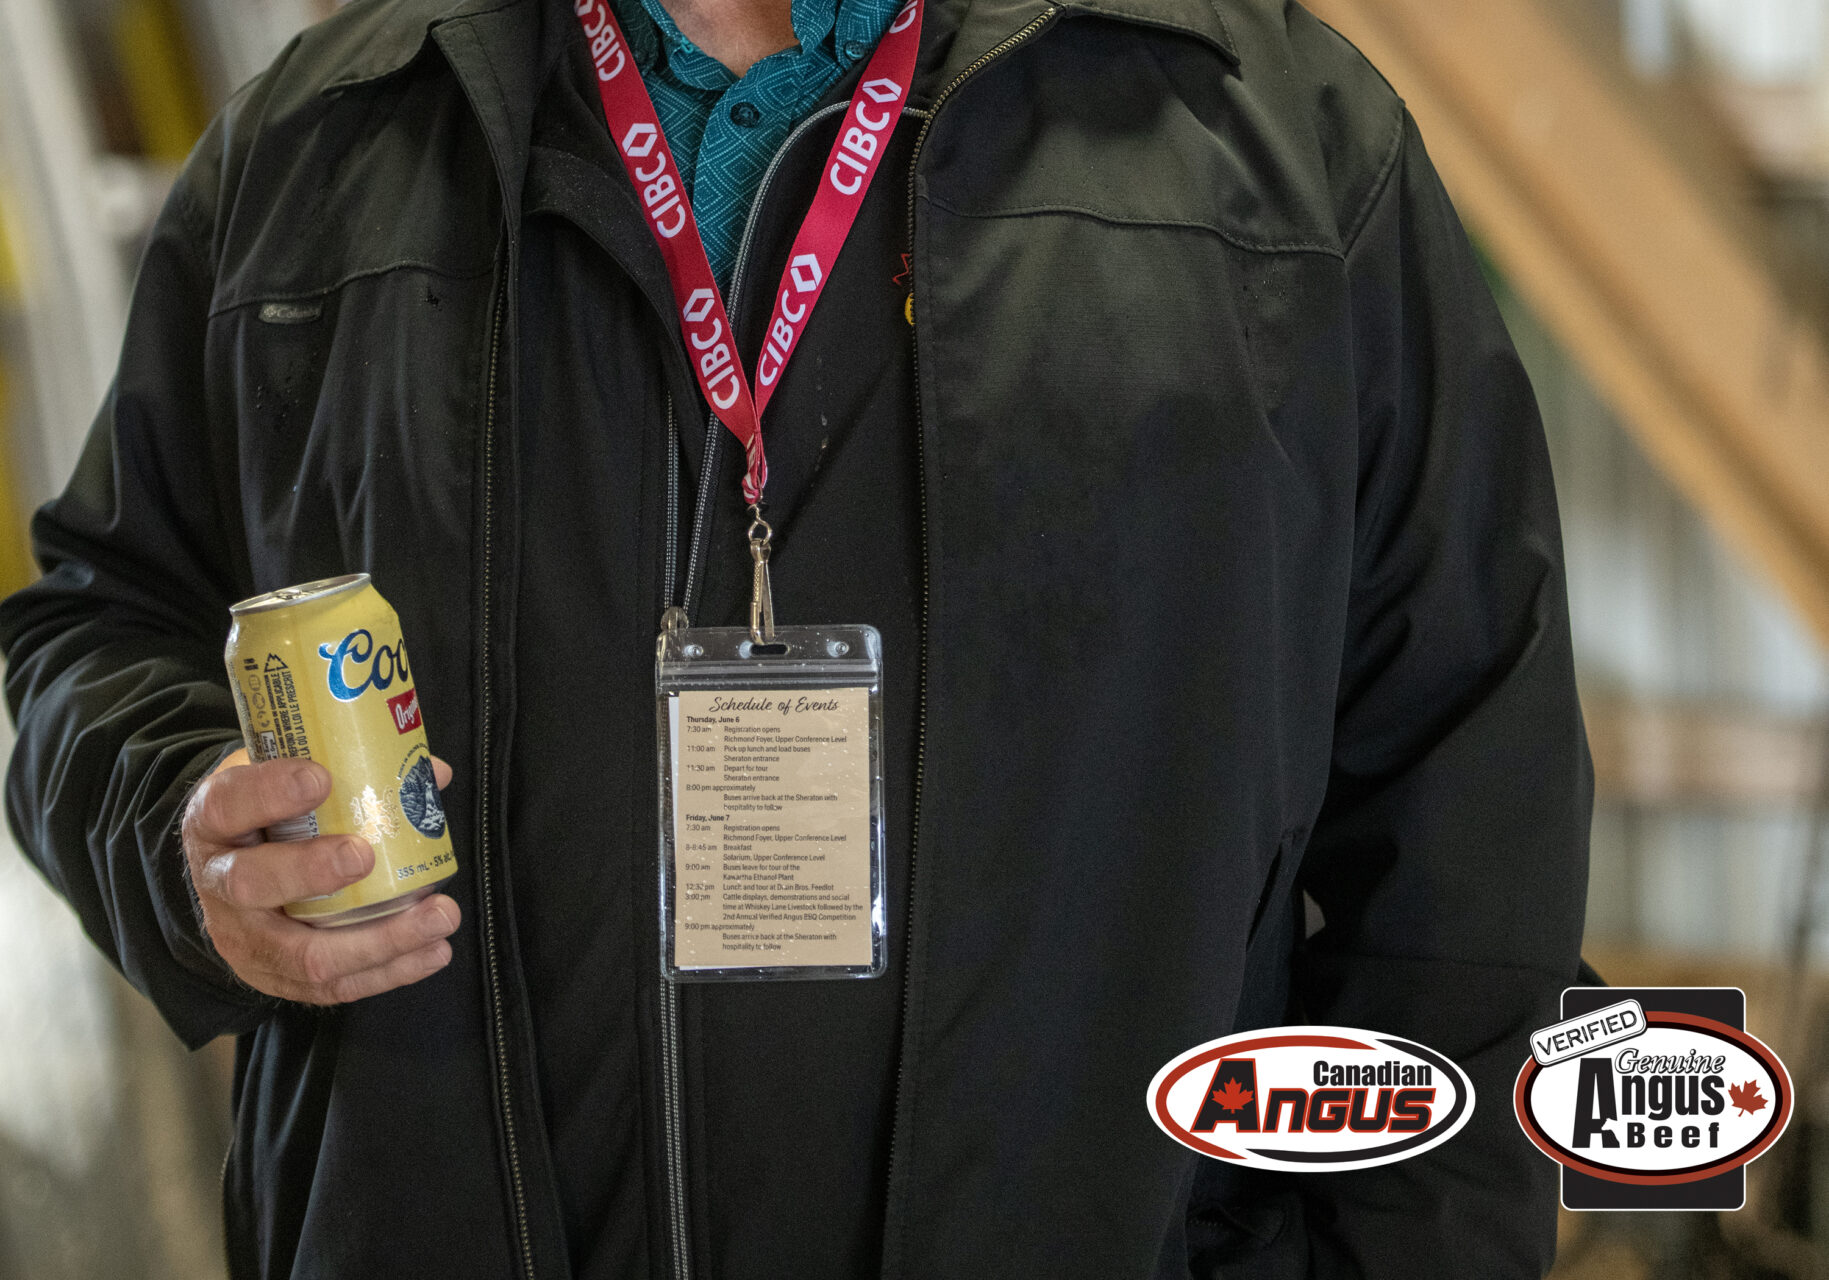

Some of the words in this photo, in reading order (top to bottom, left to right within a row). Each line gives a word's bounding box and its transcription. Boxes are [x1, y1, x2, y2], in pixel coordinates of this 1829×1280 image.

[584, 4, 625, 82] CIBC
[829, 100, 890, 196] CIBC
[635, 151, 686, 239] CIBC
[759, 289, 806, 387] CIBC
[691, 317, 740, 410] CIBC
[270, 673, 288, 709] APPLICABLE
[282, 671, 298, 703] PRESCRIT
[279, 710, 292, 732] WHERE
[290, 704, 300, 713] LE
[292, 714, 302, 725] LOI
[709, 697, 773, 712] Schedule
[777, 699, 791, 715] of
[795, 696, 838, 712] Events
[285, 732, 298, 758] REFUND
[397, 865, 414, 880] 355
[417, 861, 430, 872] mL
